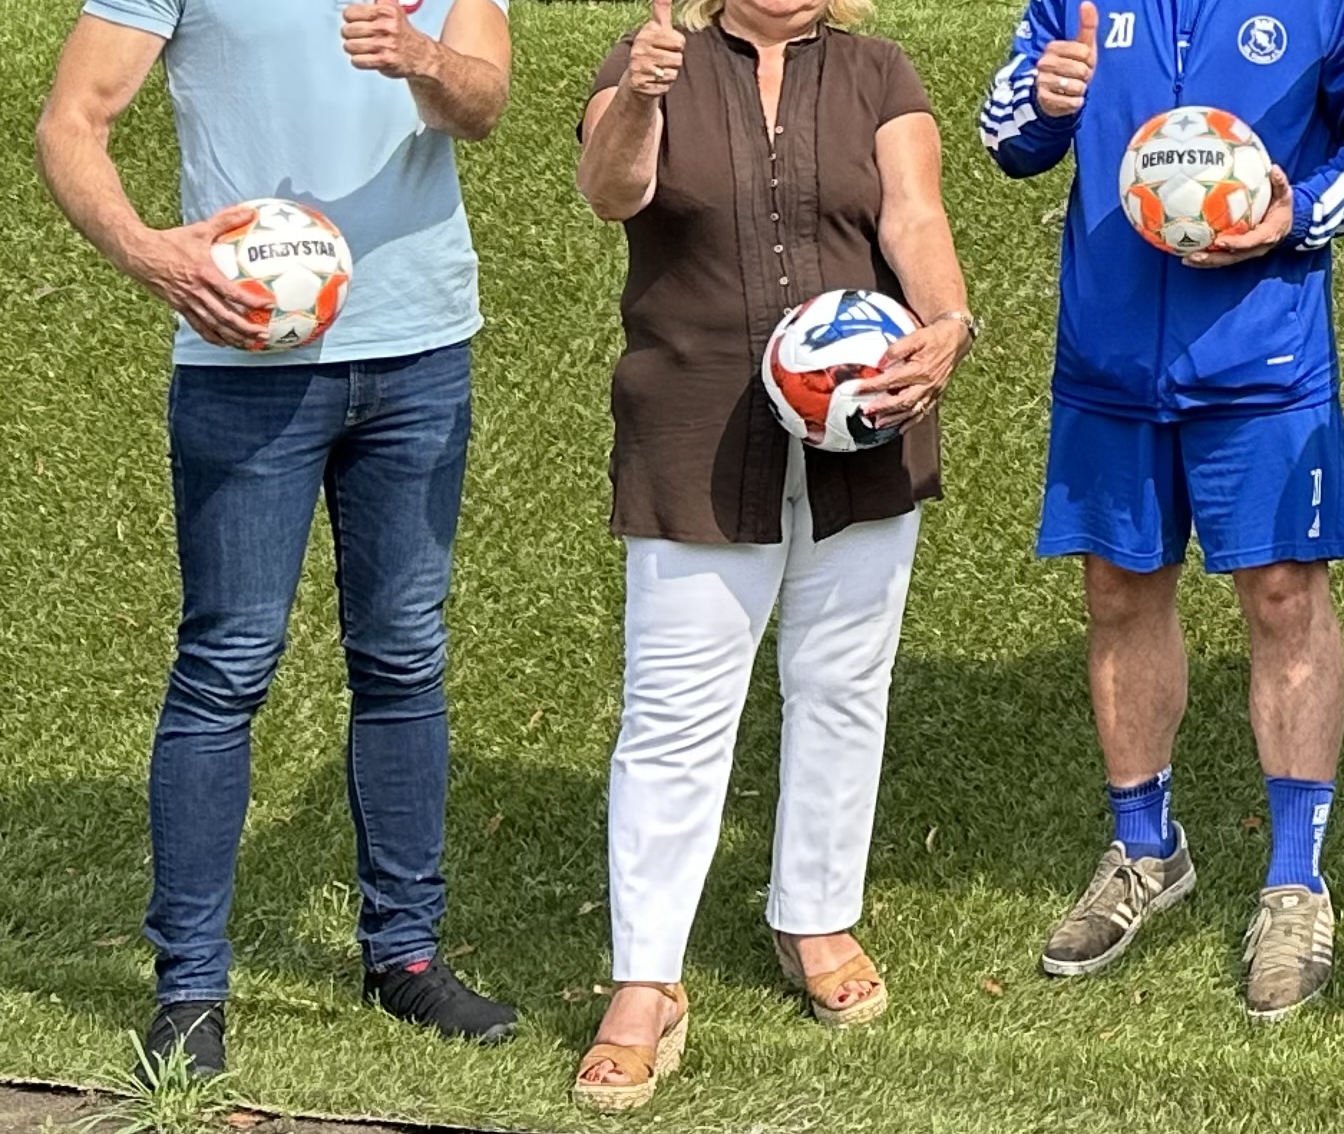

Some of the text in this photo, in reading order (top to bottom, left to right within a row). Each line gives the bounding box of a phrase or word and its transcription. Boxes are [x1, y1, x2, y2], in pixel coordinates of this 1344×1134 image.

[1104, 12, 1135, 48] 20
[1142, 149, 1225, 169] DERBYSTAR
[248, 240, 336, 262] DERBYSTAR
